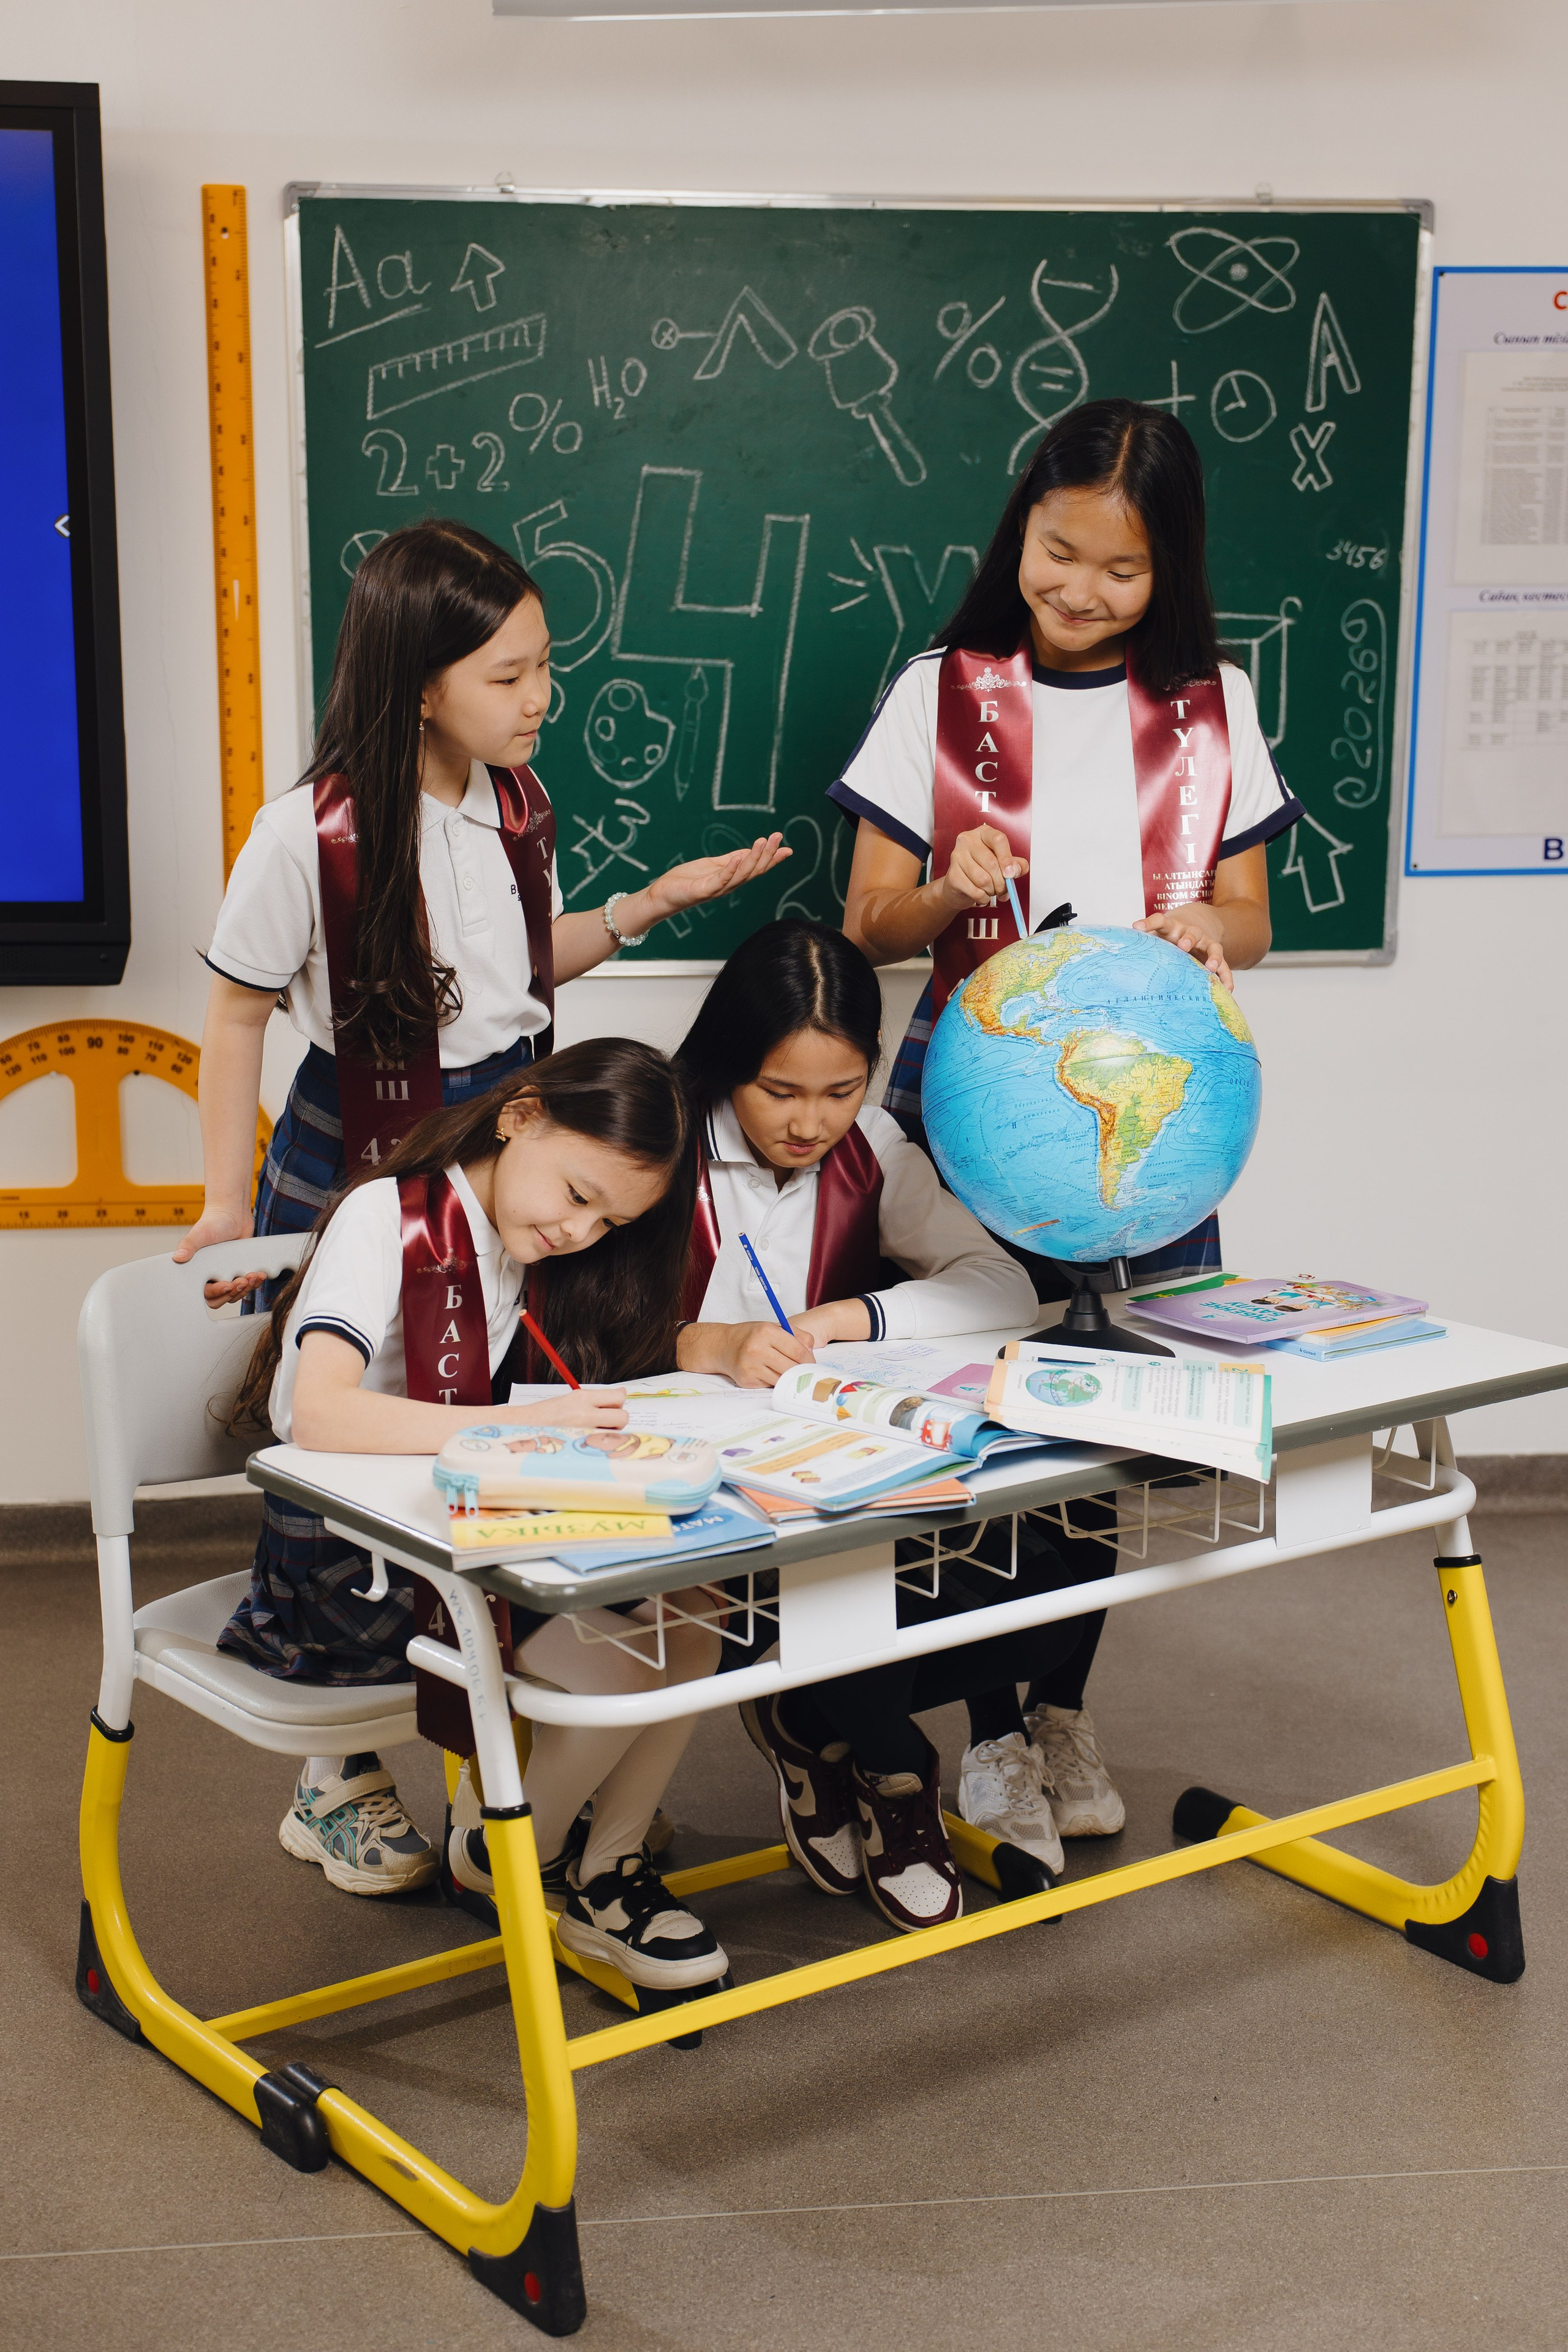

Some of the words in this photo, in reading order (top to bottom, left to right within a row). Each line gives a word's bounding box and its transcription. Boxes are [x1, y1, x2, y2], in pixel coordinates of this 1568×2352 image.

[324, 224, 431, 330] Aa
[1156, 891, 1189, 900] BINOM
[1106, 994, 1208, 1005] АТЛАНТИЧЕСКИЙ
[86, 1036, 104, 1049] 90
[477, 1519, 647, 1539] МУЗЫКА
